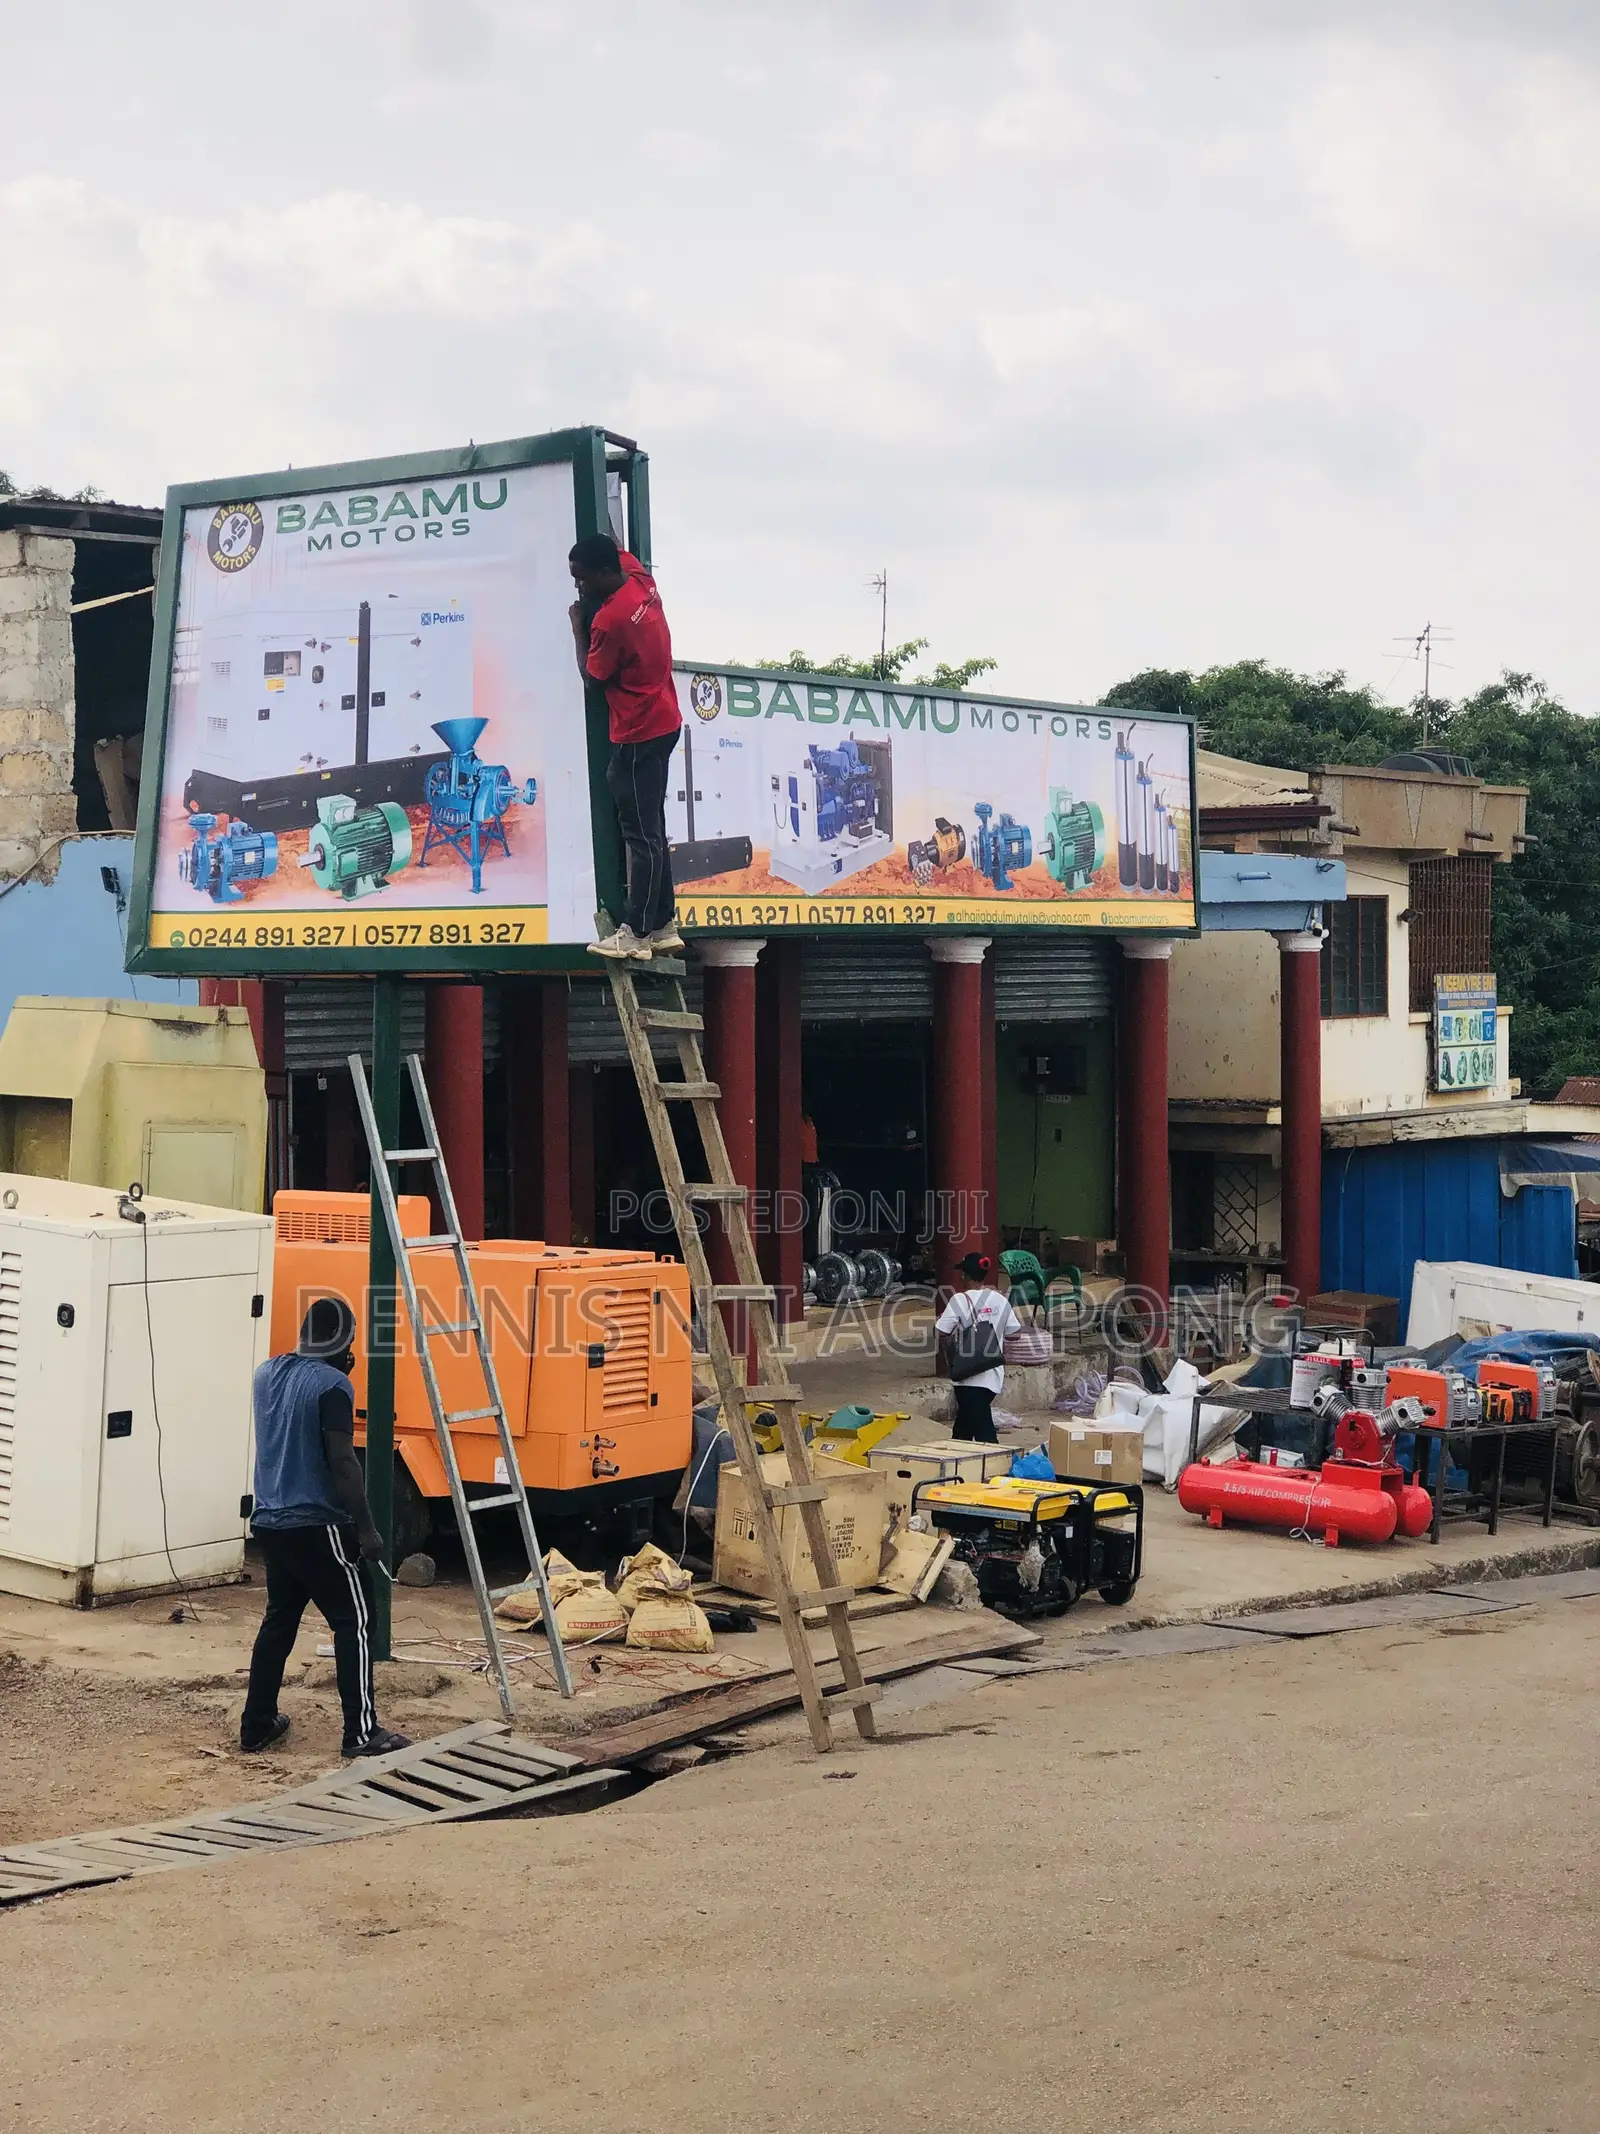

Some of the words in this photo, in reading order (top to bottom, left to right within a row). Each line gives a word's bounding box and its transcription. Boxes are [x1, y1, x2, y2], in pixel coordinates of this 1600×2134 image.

[276, 477, 508, 535] BABAMU
[307, 518, 471, 552] MOTORS
[212, 544, 257, 570] MOTORS
[432, 612, 465, 625] Perkins
[725, 676, 961, 734] BABAMU
[970, 706, 1112, 741] MOTORS
[705, 905, 743, 927] 891
[751, 905, 789, 925] 327
[808, 905, 856, 924] 0577
[863, 905, 895, 924] 891
[902, 905, 936, 924] 327
[188, 927, 247, 947] 0244
[254, 926, 294, 947] 891
[302, 926, 346, 946] 327
[364, 925, 422, 944] 0577
[429, 923, 473, 944] 891
[480, 922, 526, 943] 327
[1247, 1487, 1264, 1497] AIR
[1265, 1488, 1332, 1508] COMPRESSOR
